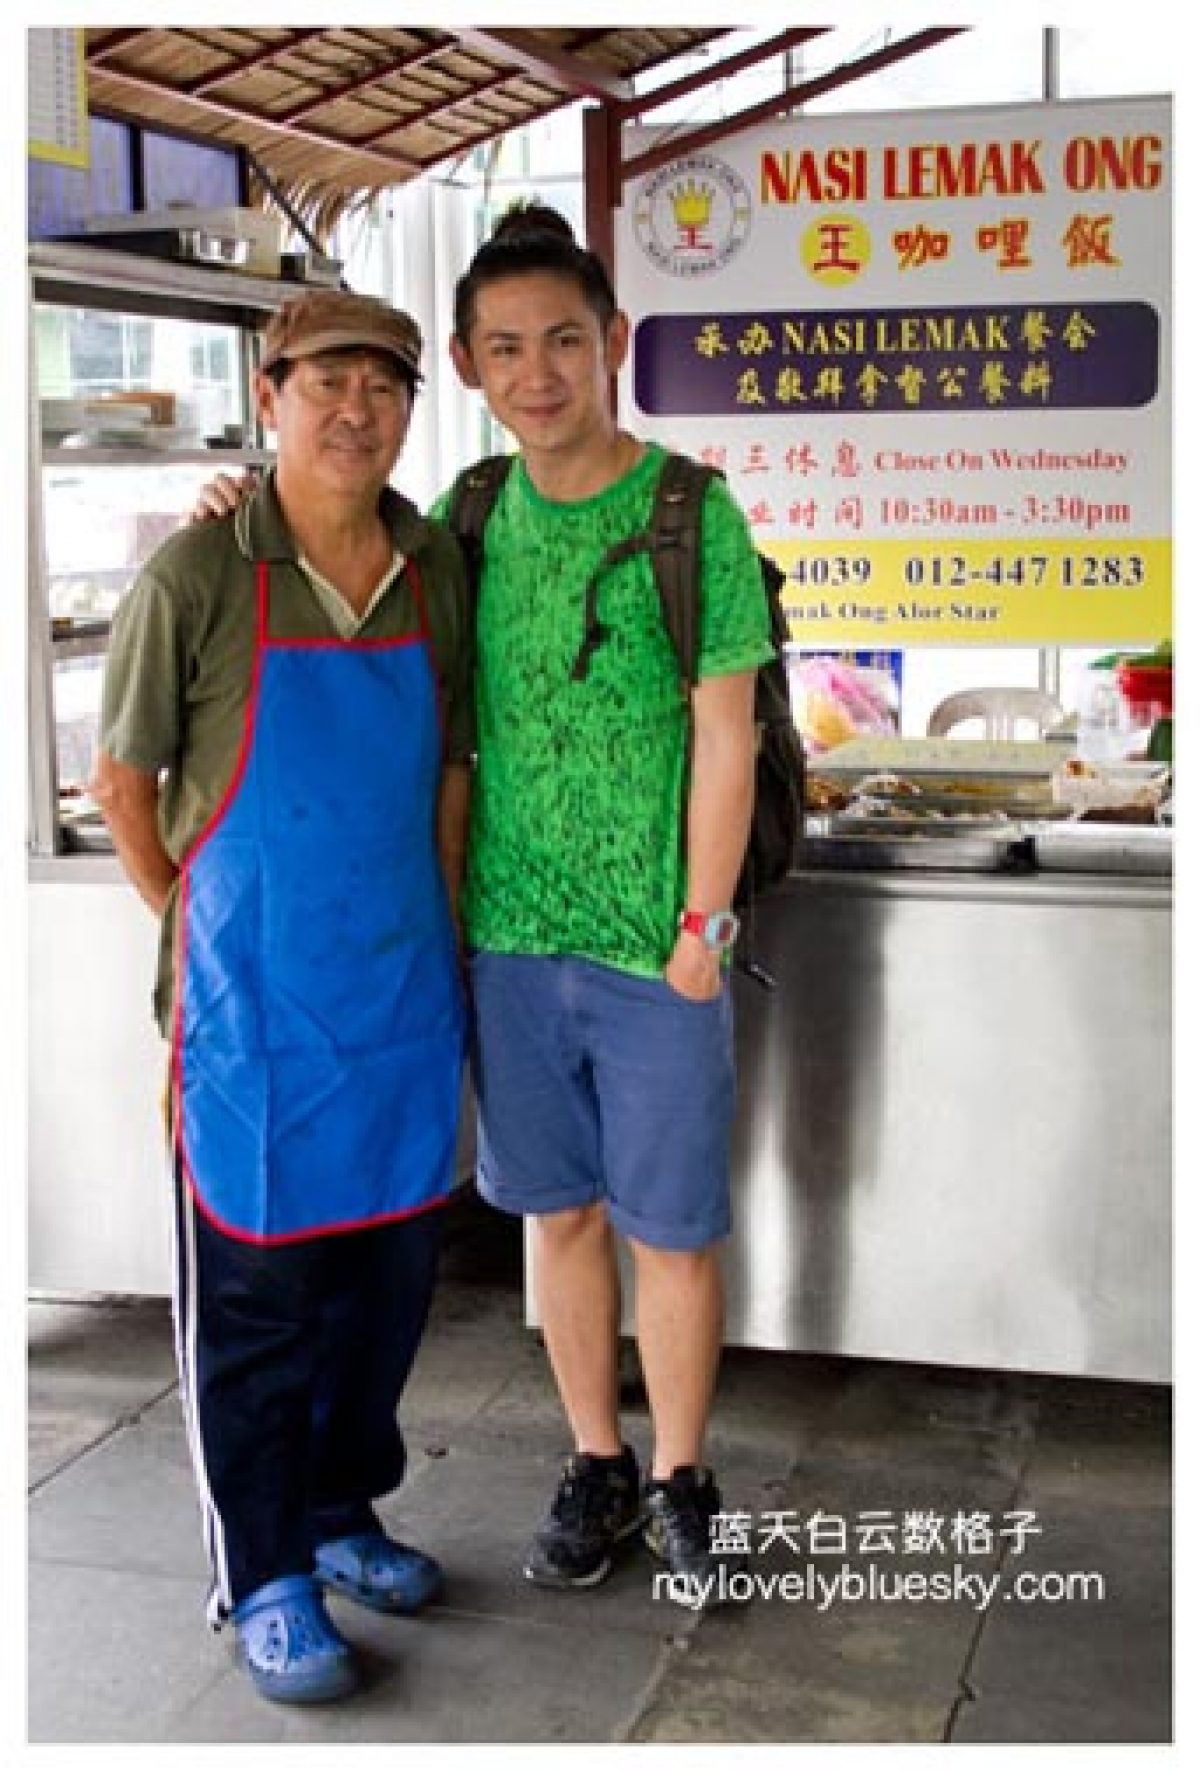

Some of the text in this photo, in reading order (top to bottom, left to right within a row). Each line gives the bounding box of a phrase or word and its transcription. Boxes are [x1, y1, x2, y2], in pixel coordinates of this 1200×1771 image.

[761, 135, 1163, 205] NASI LEMAK ONG
[781, 319, 865, 355] NASI
[876, 315, 1011, 352] LEMAK
[872, 448, 940, 471] Close
[946, 449, 984, 471] On
[990, 447, 1129, 475] Wednesday
[880, 499, 998, 525] 10:30am
[1022, 496, 1131, 529] 3:30pm
[905, 556, 1048, 587] 012-447
[1061, 556, 1145, 588] 1283
[838, 602, 886, 623] Ong
[897, 602, 941, 619] Alor
[950, 602, 999, 620] Star
